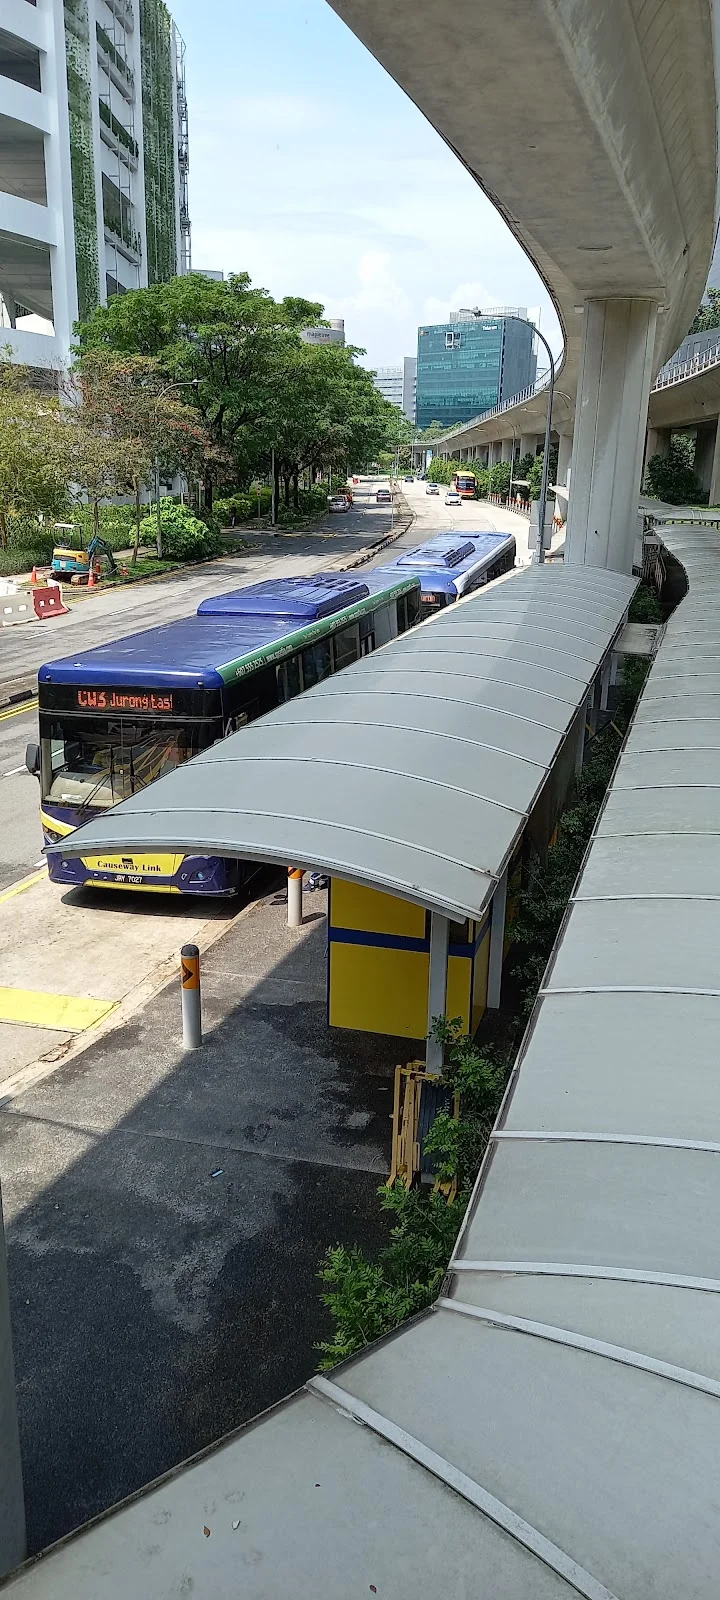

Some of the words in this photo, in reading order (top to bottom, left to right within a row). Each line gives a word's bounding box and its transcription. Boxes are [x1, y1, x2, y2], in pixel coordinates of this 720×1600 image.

[110, 692, 149, 710] Jurong
[97, 860, 139, 872] Causeway
[142, 864, 161, 872] Link
